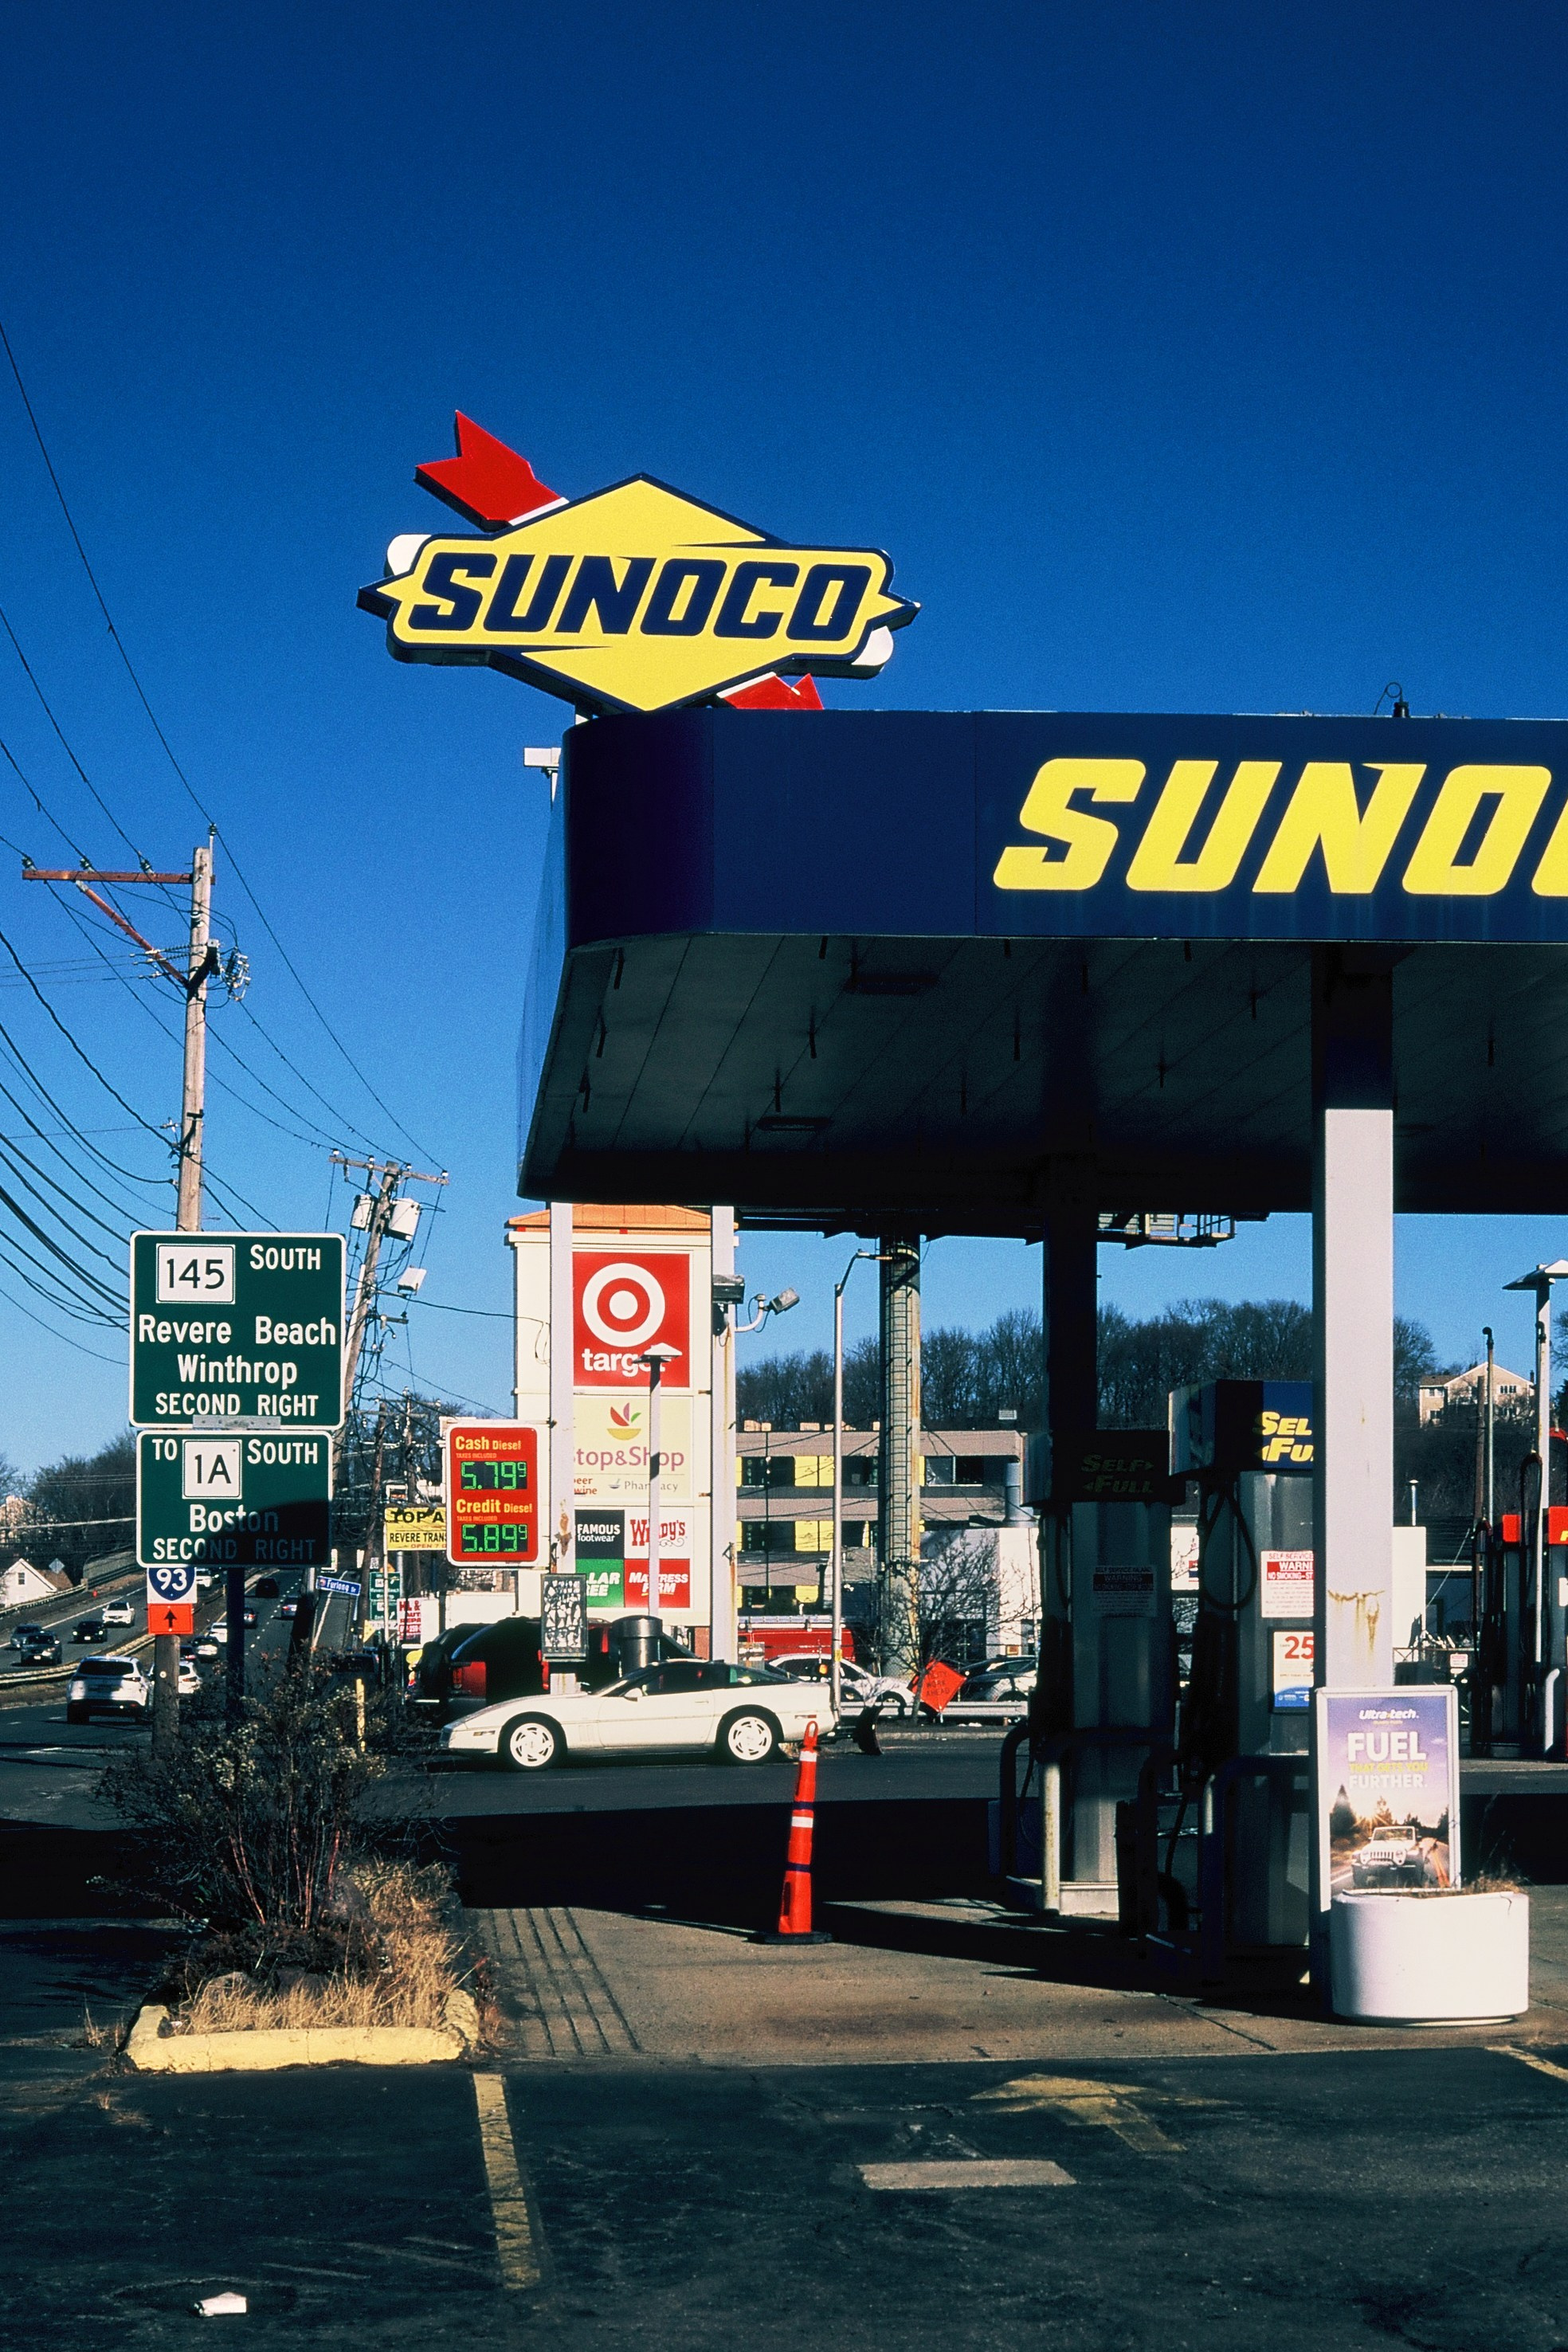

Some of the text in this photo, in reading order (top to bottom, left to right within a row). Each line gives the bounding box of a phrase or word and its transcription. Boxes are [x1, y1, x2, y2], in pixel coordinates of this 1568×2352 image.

[408, 551, 872, 641] SUNOCO
[249, 1244, 321, 1271] SOUTH
[166, 1259, 225, 1288] 145
[139, 1315, 336, 1345] Revere Beach
[177, 1354, 297, 1389] Winthrop
[582, 1348, 665, 1377] targ
[155, 1393, 319, 1417] SECOND RIGHT
[1252, 1411, 1313, 1435] SEL
[151, 1438, 178, 1460] TO
[247, 1439, 318, 1464] SOUTH
[456, 1436, 521, 1450] Cash Diesel
[1267, 1437, 1315, 1462] FU
[194, 1454, 231, 1484] 1A
[573, 1446, 684, 1472] top&Shop
[624, 1481, 678, 1492] Pharacy
[390, 1511, 426, 1523] TOP
[456, 1499, 532, 1513] Credit Diesel
[190, 1504, 280, 1533] Boston
[577, 1524, 620, 1535] FAMOUS
[153, 1538, 316, 1561] SECOND RIGHT
[390, 1533, 420, 1543] REVERE
[629, 1572, 688, 1583] MATRESS
[1279, 1562, 1313, 1570] WARNI
[155, 1569, 188, 1591] 93
[642, 1583, 676, 1593] FRM
[1347, 1731, 1427, 1762] FUEL
[1350, 1761, 1429, 1772] THAT GETS YOU
